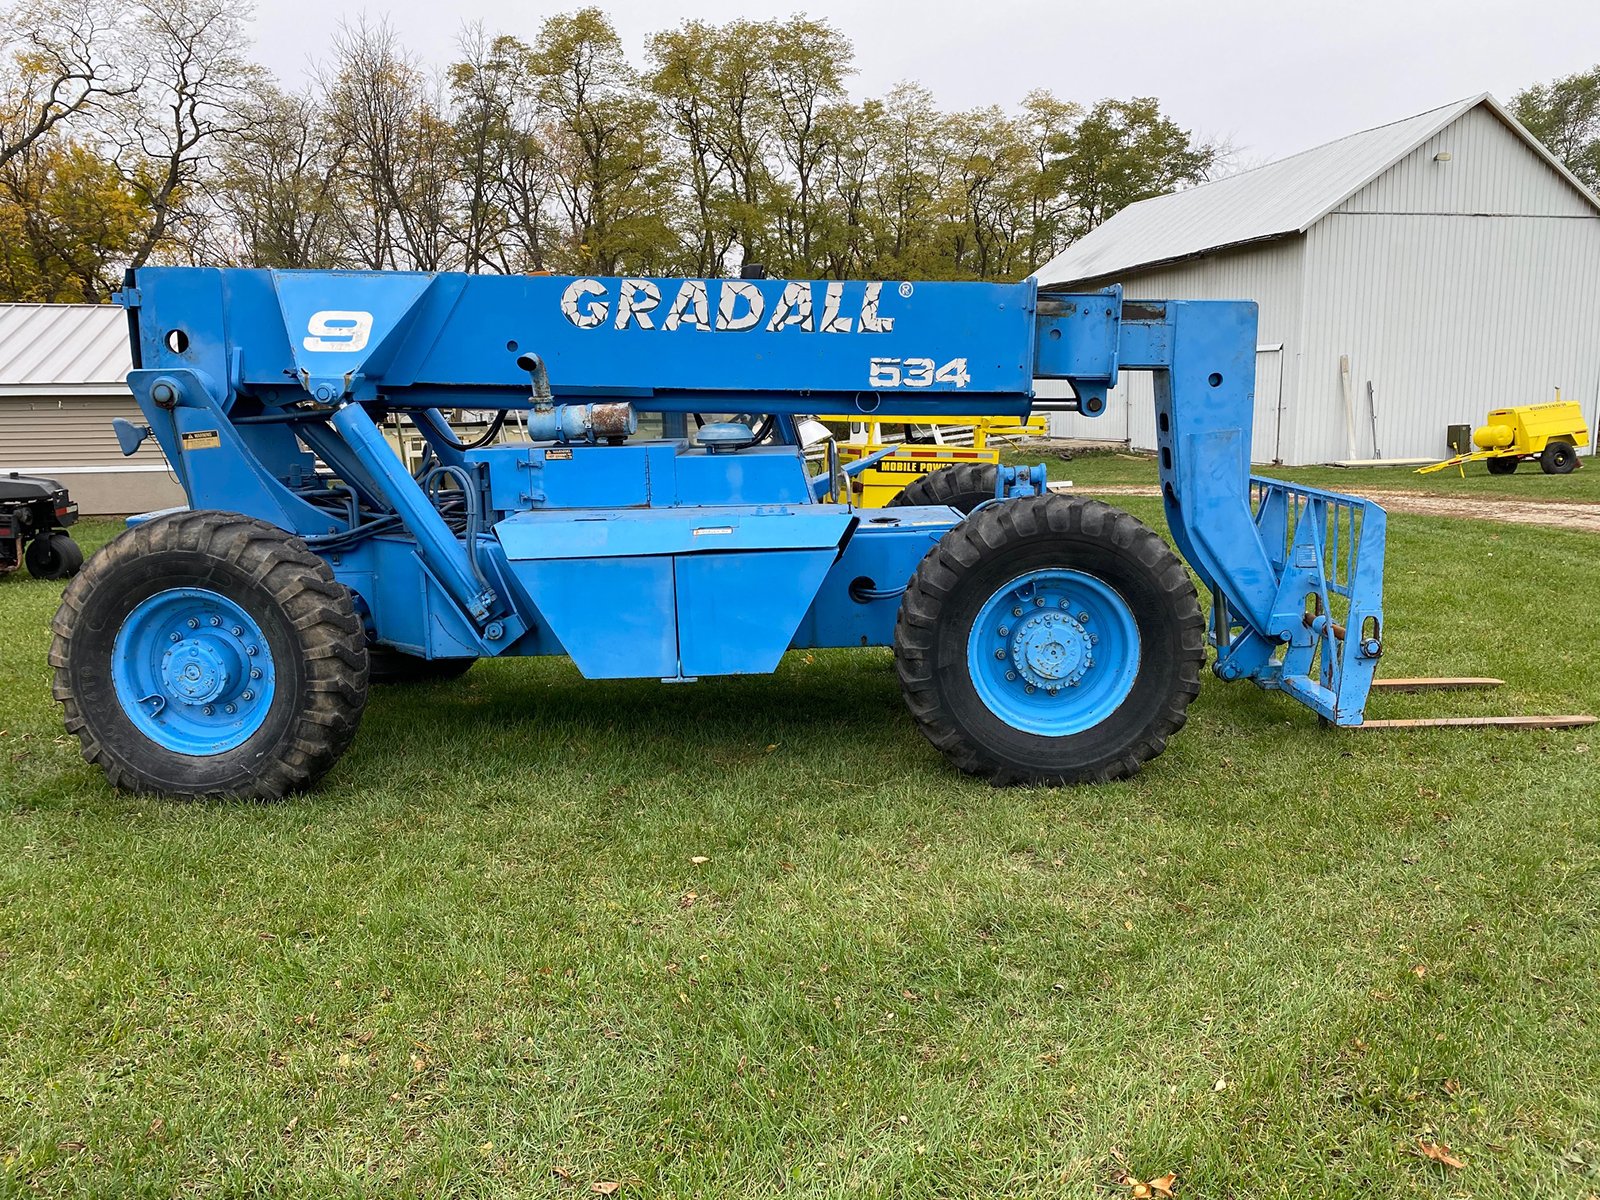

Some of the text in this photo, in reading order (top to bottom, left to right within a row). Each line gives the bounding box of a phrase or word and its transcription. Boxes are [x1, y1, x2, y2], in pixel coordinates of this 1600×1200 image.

[560, 278, 896, 334] GRADALL
[302, 310, 374, 353] 9
[869, 357, 971, 388] 534
[881, 461, 917, 472] MOBILE
